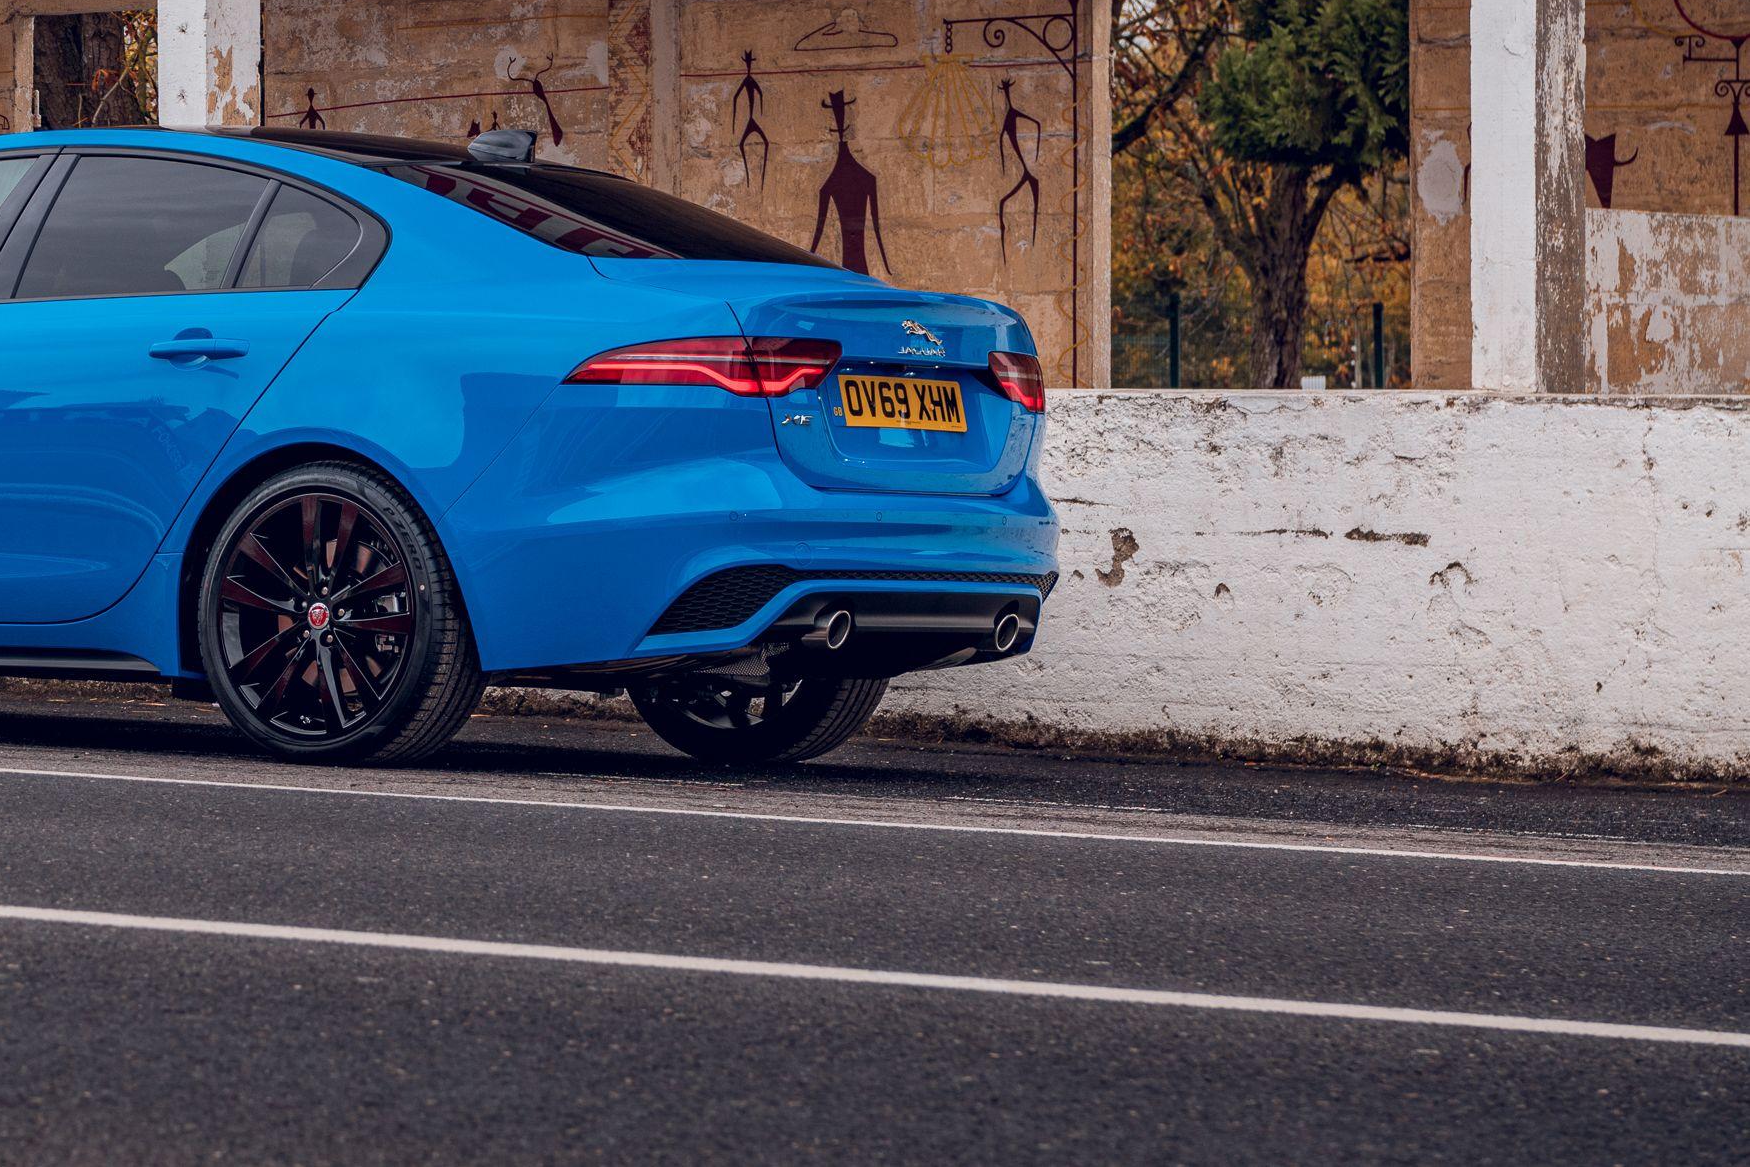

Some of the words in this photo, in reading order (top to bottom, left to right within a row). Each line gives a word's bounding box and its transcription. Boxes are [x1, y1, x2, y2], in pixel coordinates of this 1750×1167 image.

[897, 346, 946, 357] JAGUAR
[845, 380, 910, 419] OV69
[913, 384, 962, 423] XHM
